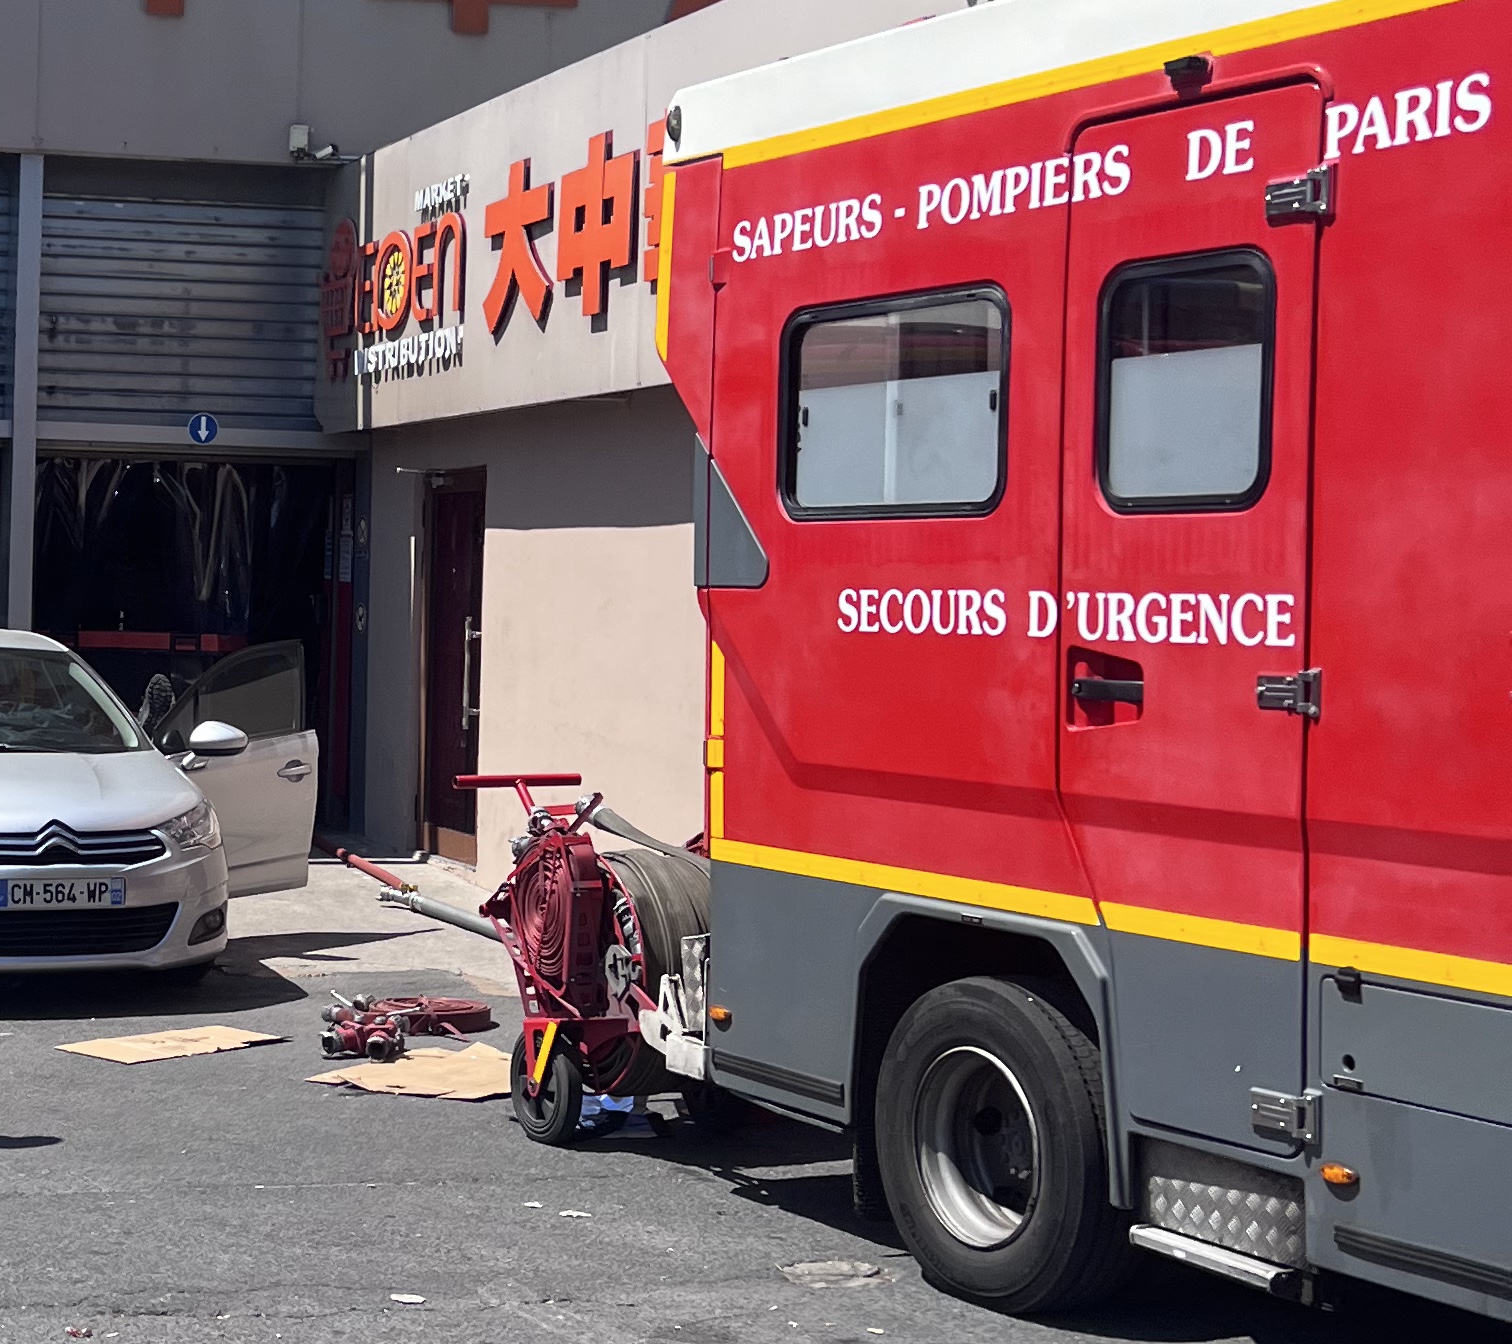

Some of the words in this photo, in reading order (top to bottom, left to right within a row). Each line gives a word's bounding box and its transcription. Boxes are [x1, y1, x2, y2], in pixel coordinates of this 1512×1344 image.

[414, 173, 463, 212] MARKET
[731, 194, 883, 264] SAPEURS
[916, 145, 1132, 230] POMPIERS
[1185, 120, 1255, 183] DE
[1323, 72, 1493, 160] PARIS
[482, 112, 666, 335] 大中
[354, 325, 460, 376] DISTRIBUTION
[837, 588, 1007, 636] SECOURS
[1026, 592, 1296, 648] D'URGENCE
[10, 882, 109, 905] CM-564-WP
